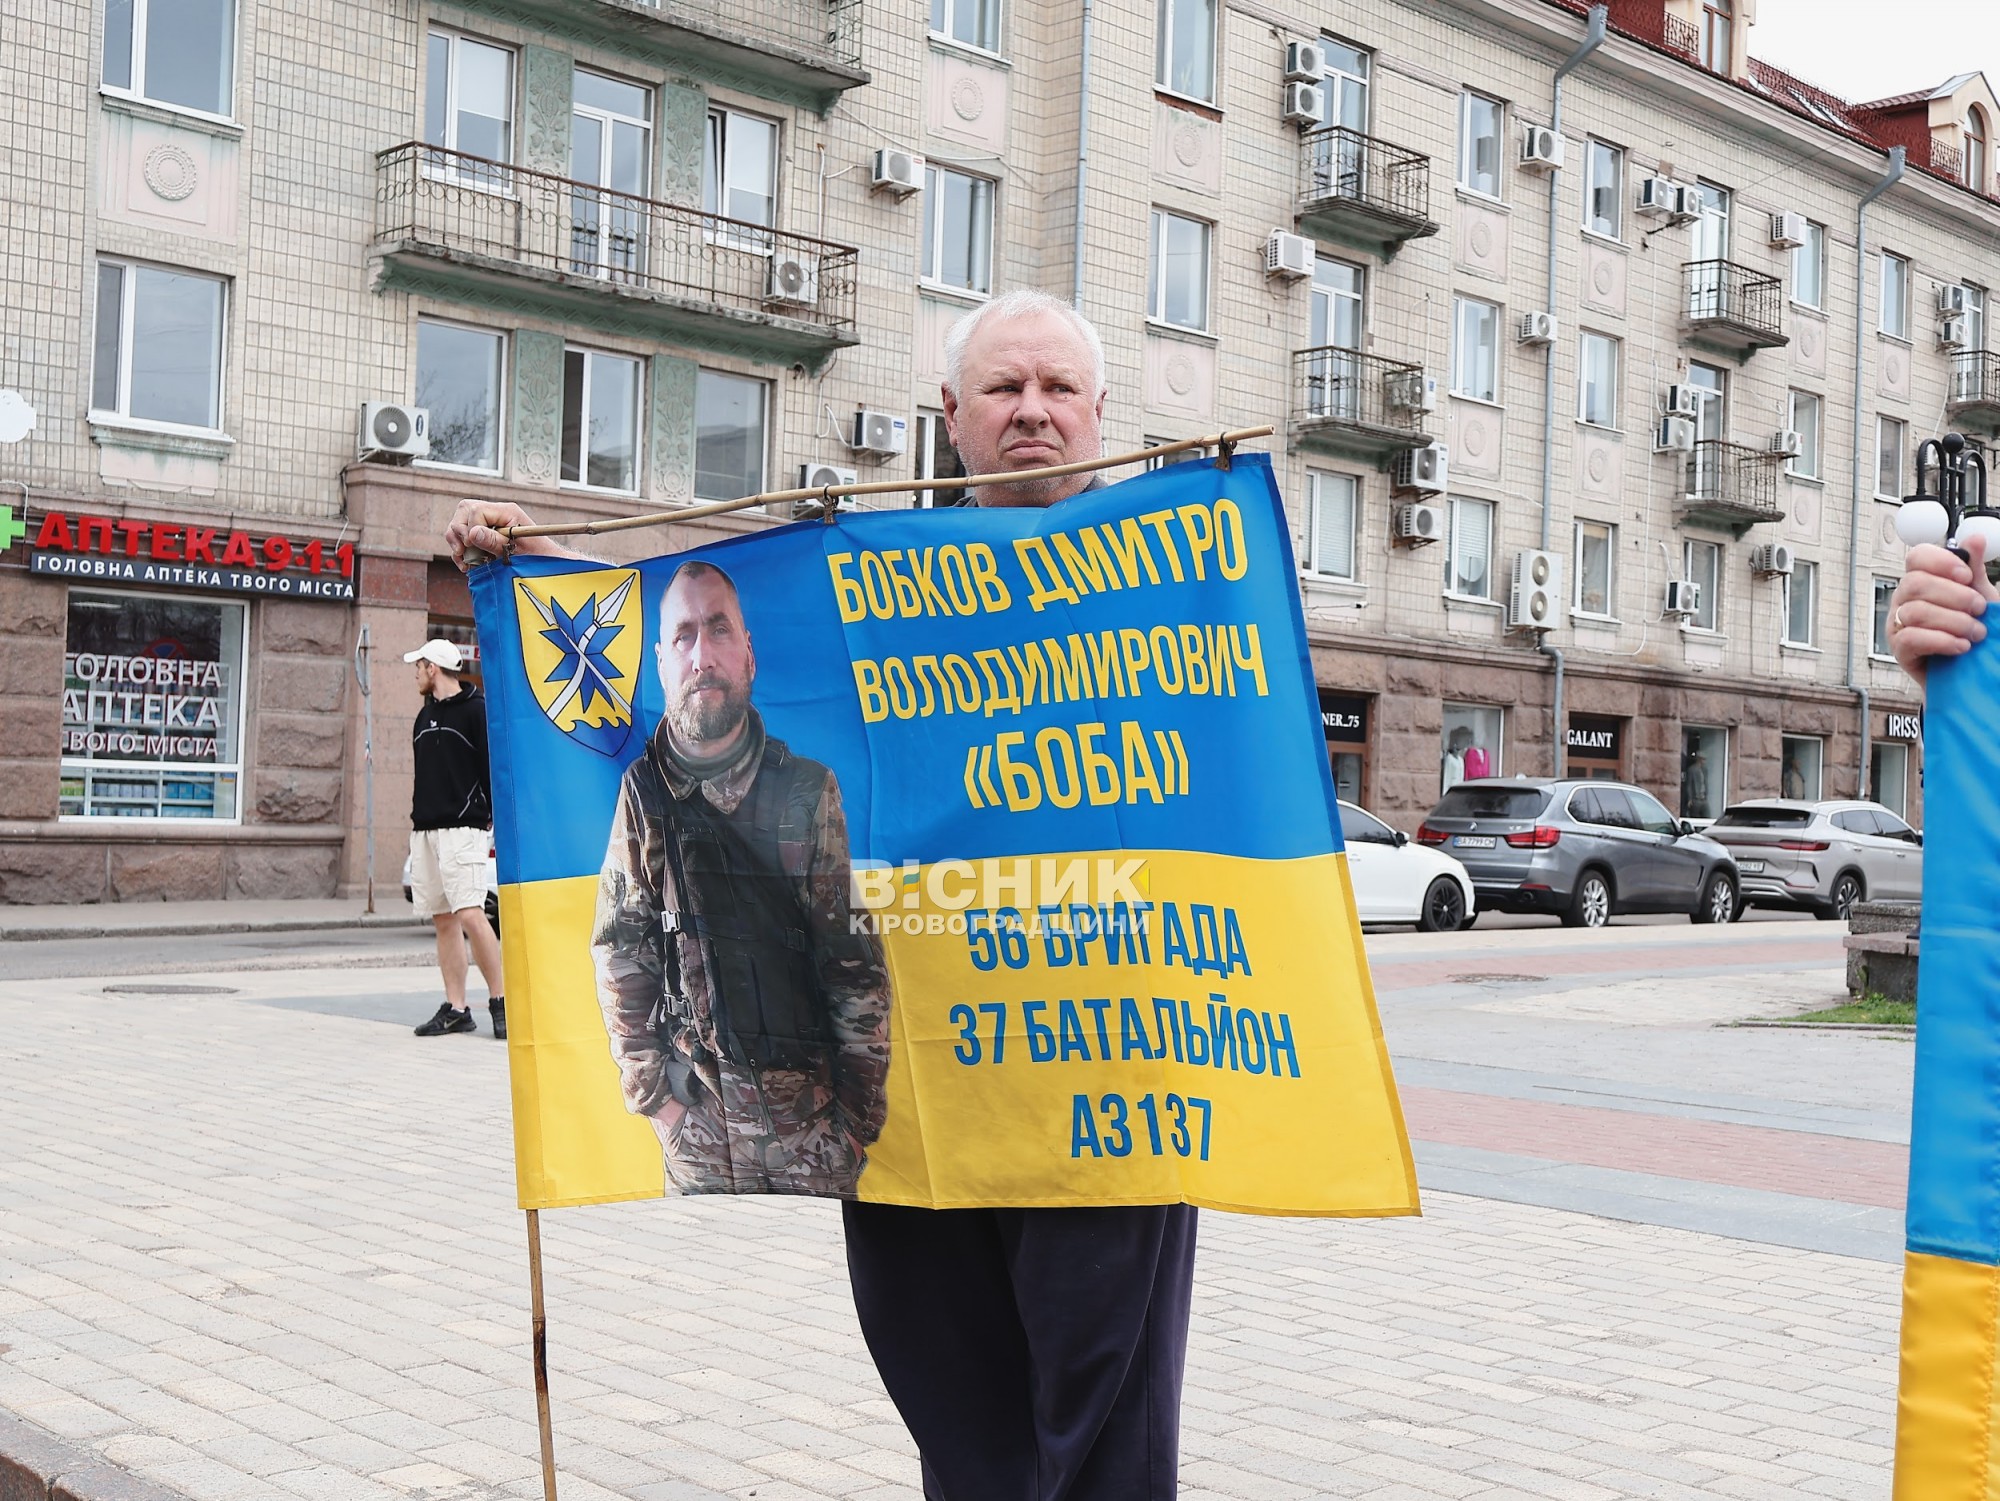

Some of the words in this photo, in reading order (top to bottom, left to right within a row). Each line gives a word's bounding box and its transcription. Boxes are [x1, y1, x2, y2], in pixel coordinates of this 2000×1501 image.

[35, 512, 256, 567] АПТЕКА
[827, 542, 1011, 624] БОБКОВ
[1012, 498, 1249, 613] ДМИТРО
[37, 556, 135, 578] ГОЛОВНА
[144, 566, 221, 586] АПТЕКА
[231, 574, 291, 592] ТВОГО
[299, 581, 354, 597] МІСТА
[852, 623, 1269, 724] ВОЛОДИМИРОВИЧ
[63, 688, 222, 728] АПТЕКА
[1567, 729, 1613, 748] GALANT
[145, 734, 218, 757] МІСТА
[963, 720, 1190, 813] «БОБА»
[964, 906, 1030, 972] 56
[1038, 902, 1252, 979] БРИГАДА
[949, 1001, 1008, 1066] 37
[1022, 992, 1302, 1079] БАТАЛЬЙОН
